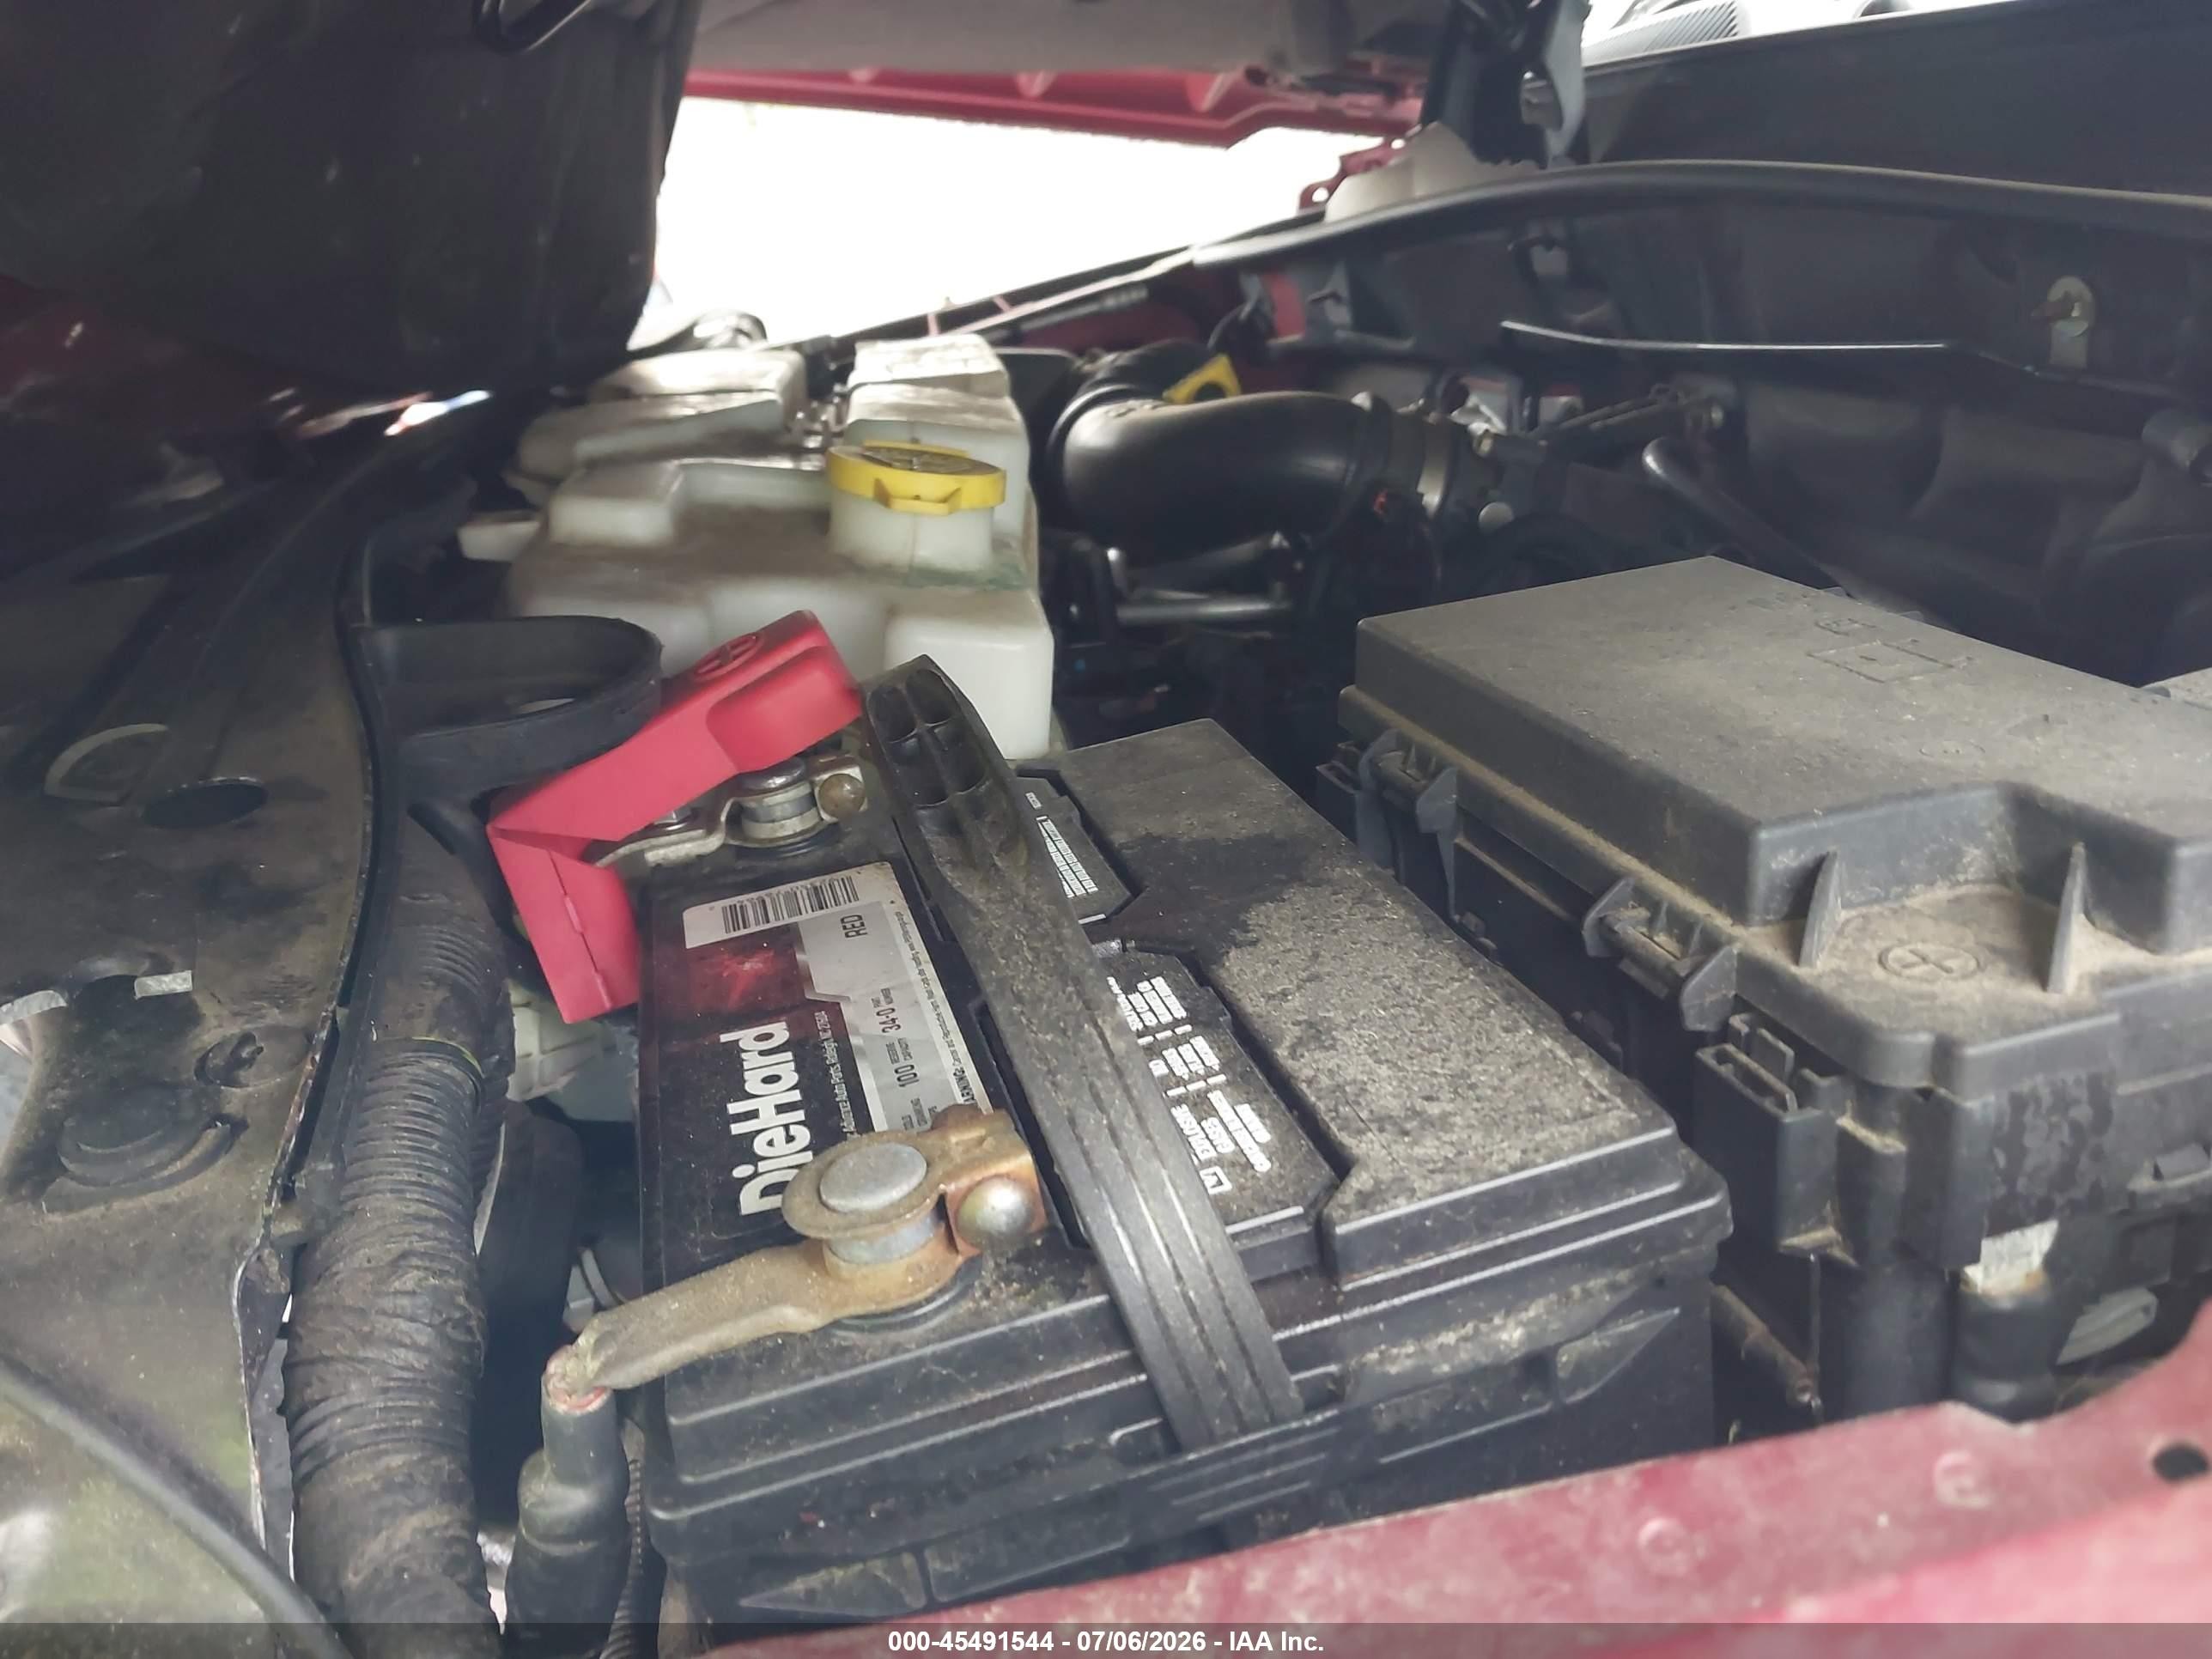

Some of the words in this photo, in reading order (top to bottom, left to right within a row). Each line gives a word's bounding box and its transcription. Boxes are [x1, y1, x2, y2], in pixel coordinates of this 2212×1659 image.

[841, 915, 868, 938] RED
[894, 1064, 920, 1088] 100
[720, 1021, 813, 1215] DieHard
